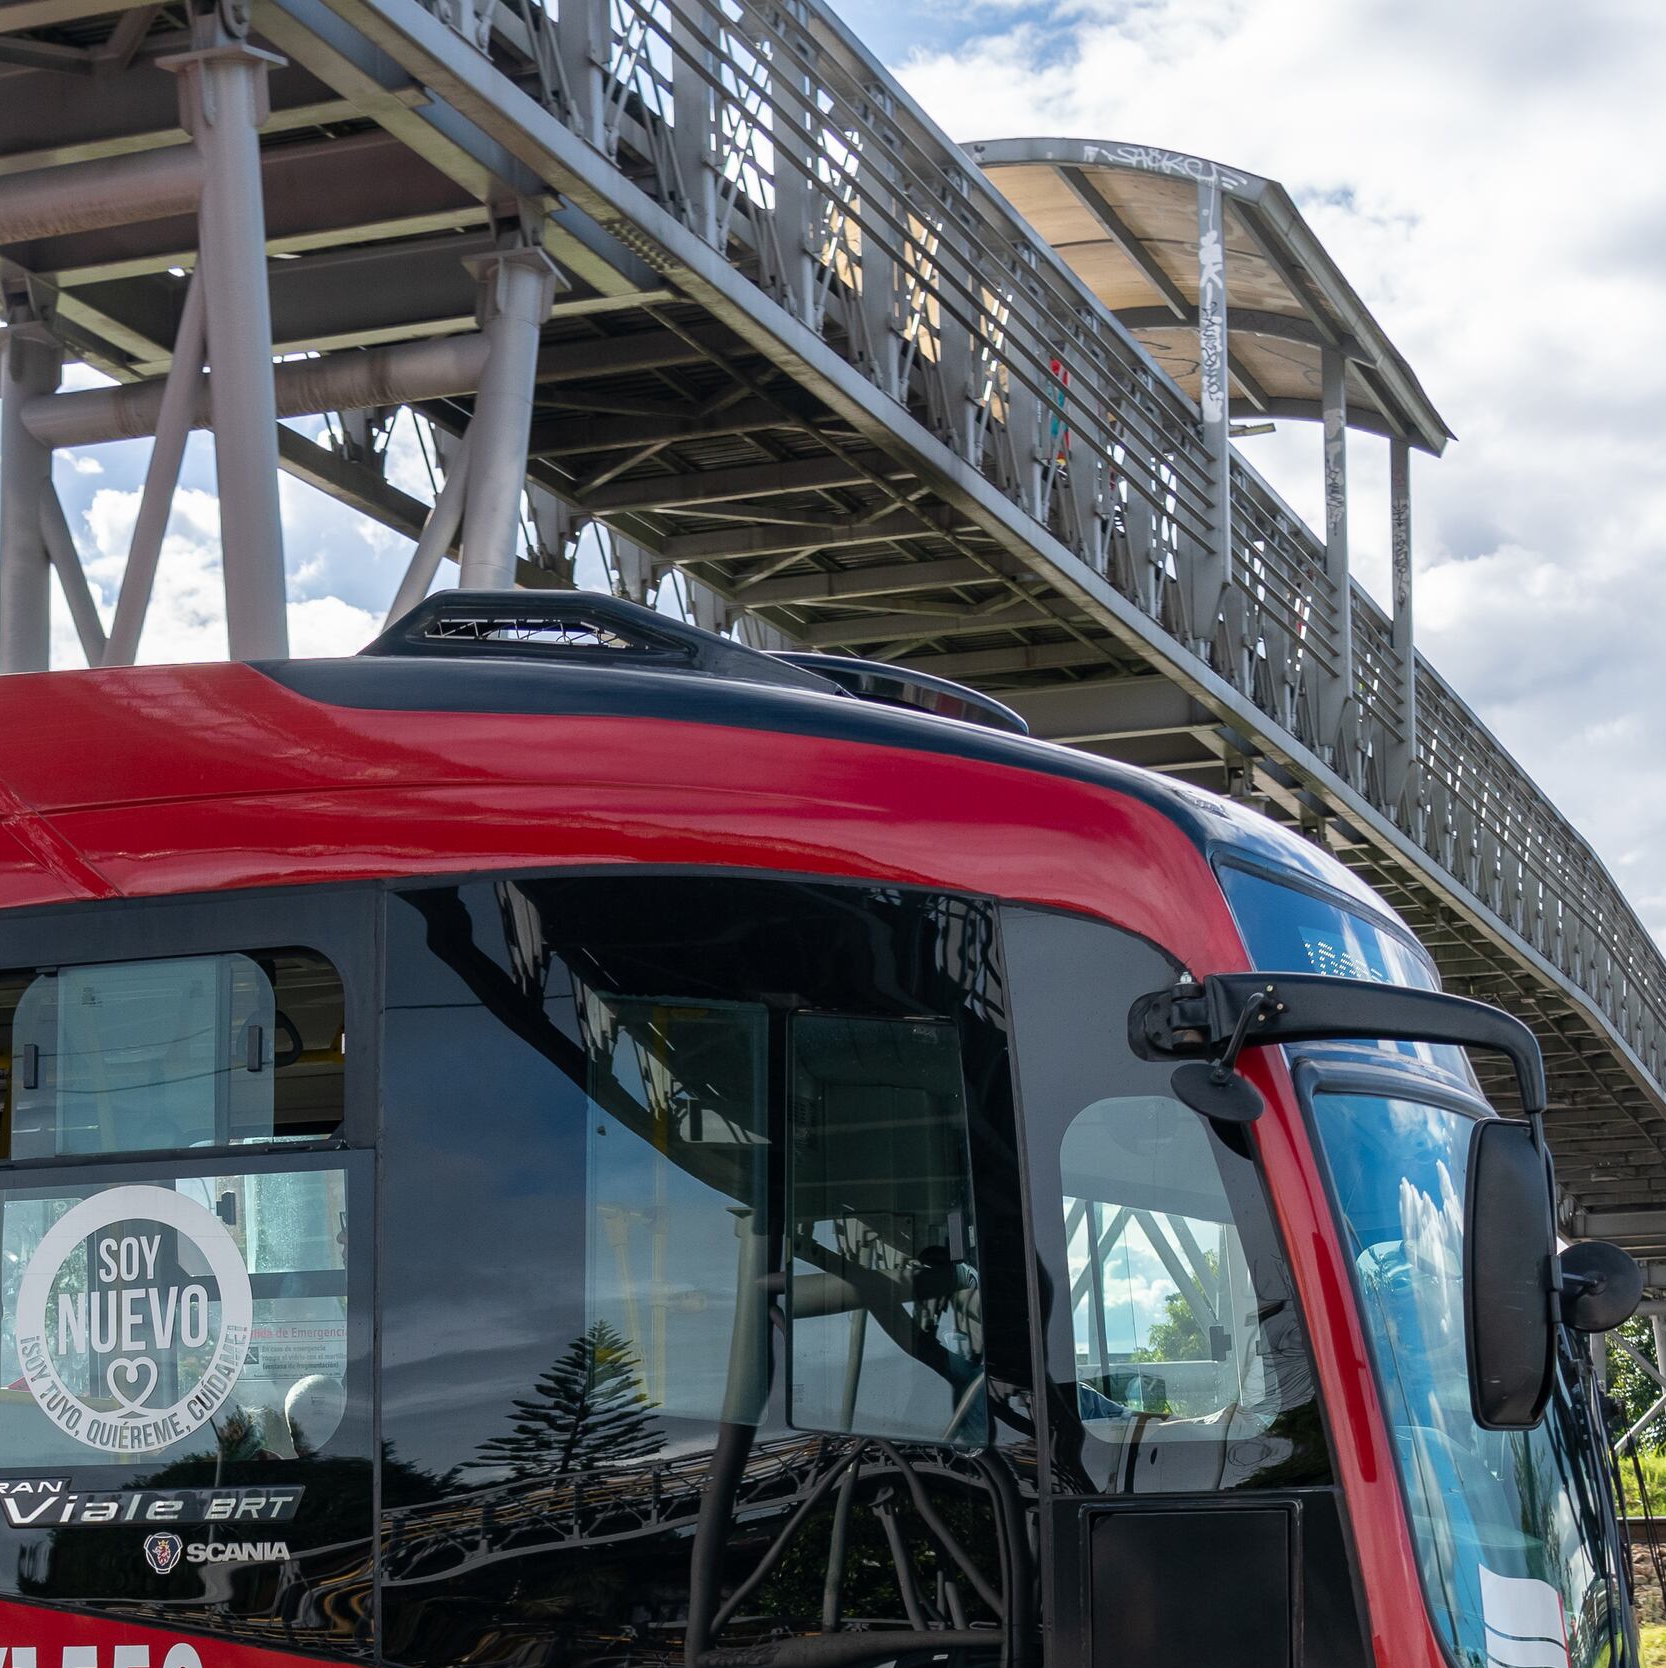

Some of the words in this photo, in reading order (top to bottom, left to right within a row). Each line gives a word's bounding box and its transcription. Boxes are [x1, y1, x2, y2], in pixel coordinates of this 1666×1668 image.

[99, 1234, 161, 1283] SOY
[57, 1284, 209, 1356] NUEVO
[4, 1494, 181, 1524] Viale
[204, 1496, 294, 1520] BRT
[186, 1542, 290, 1562] SCANIA
